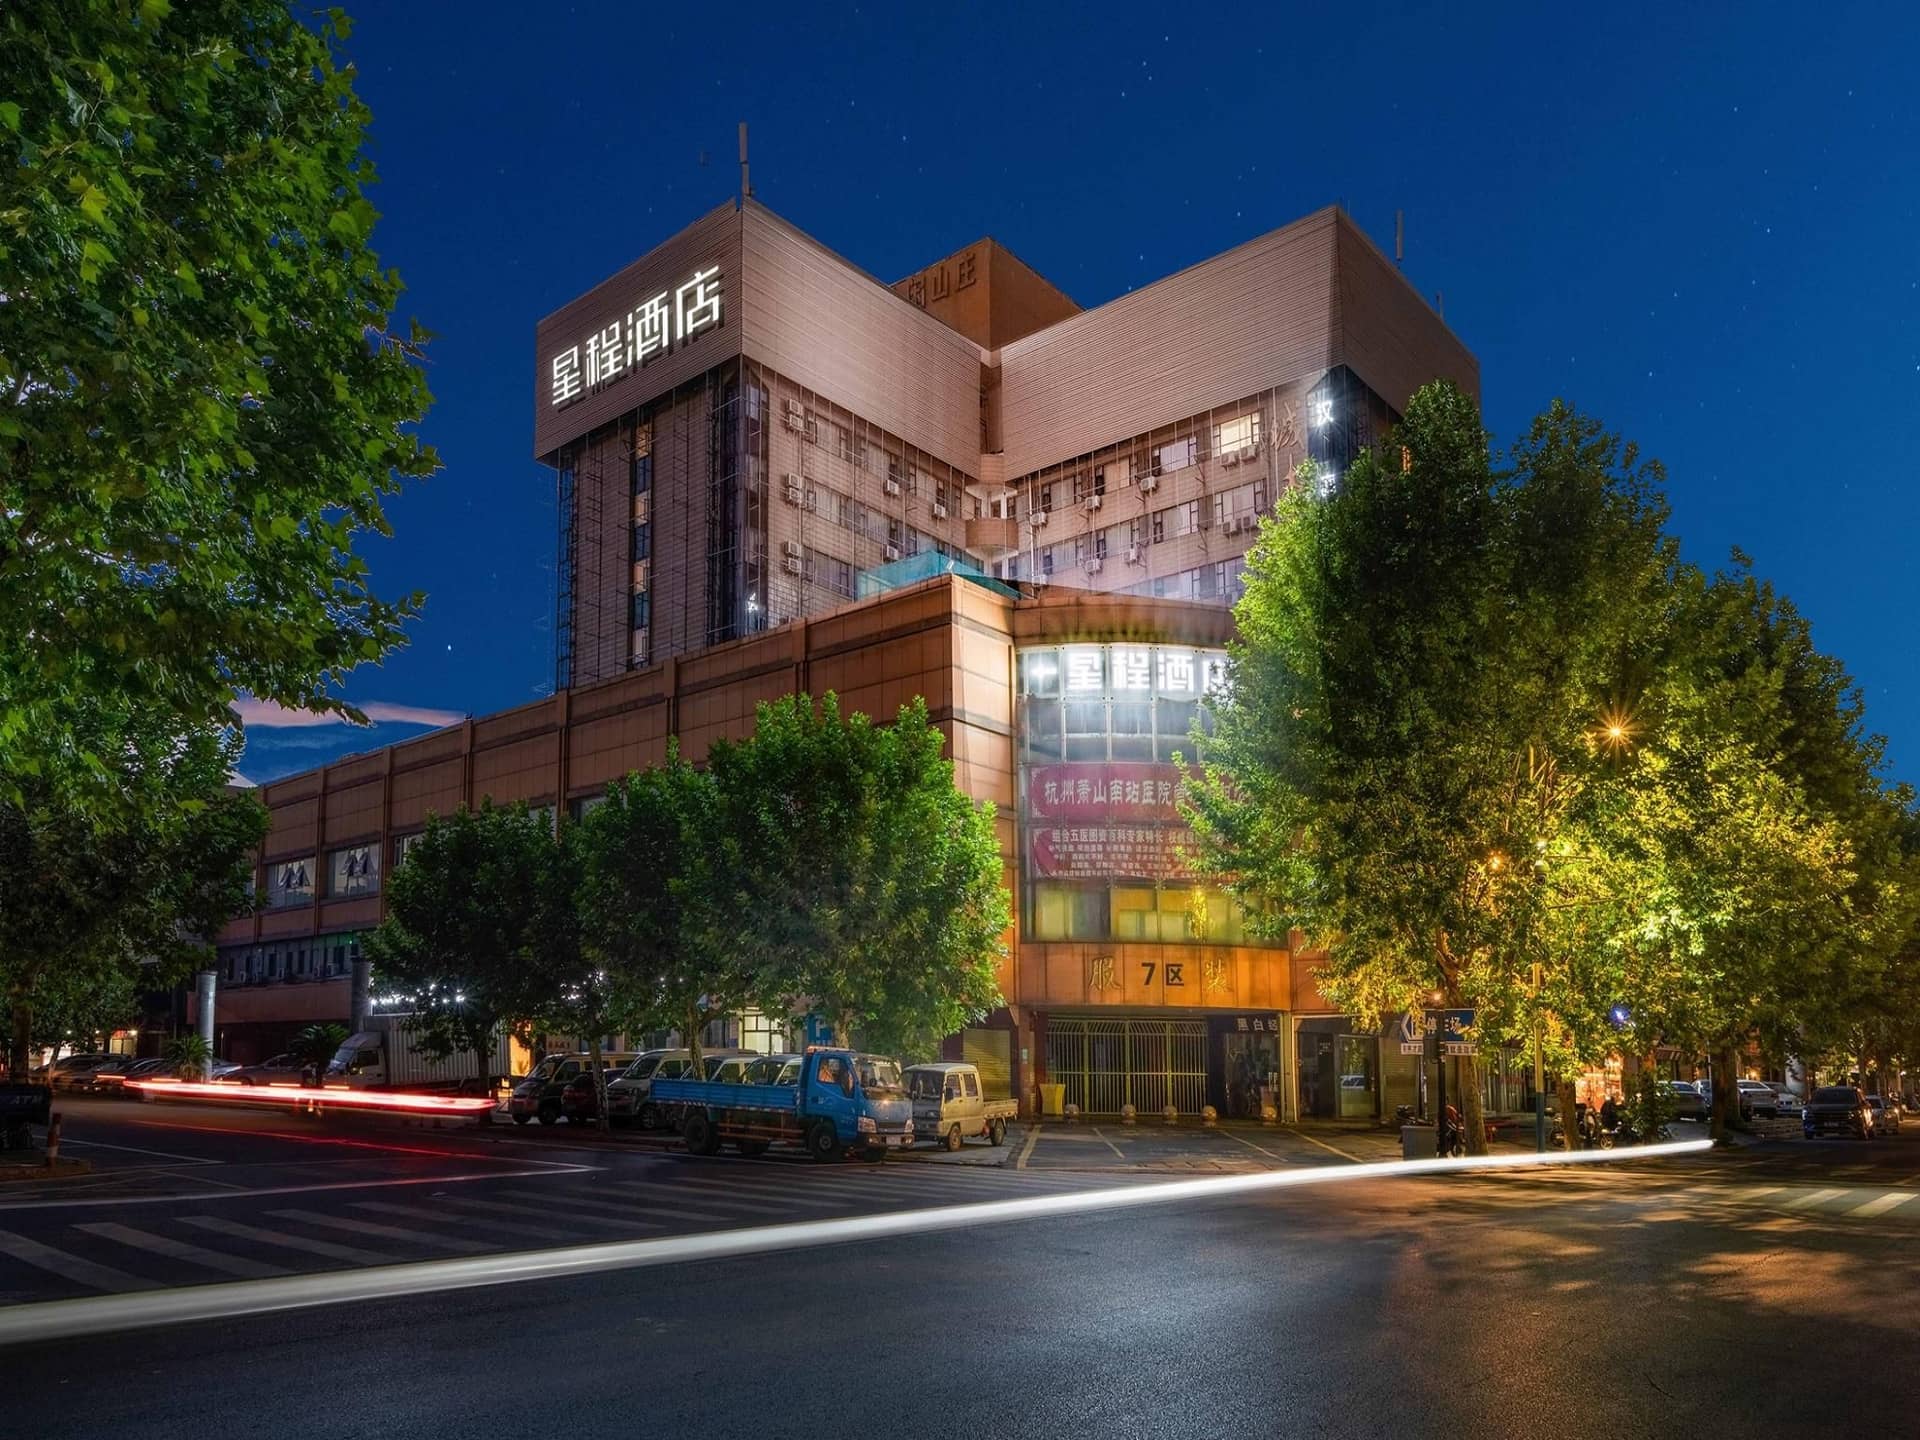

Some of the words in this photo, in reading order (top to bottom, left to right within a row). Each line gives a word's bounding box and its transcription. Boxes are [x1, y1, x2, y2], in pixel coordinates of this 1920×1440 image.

[552, 265, 720, 405] 星程酒店
[1142, 962, 1184, 987] 7区
